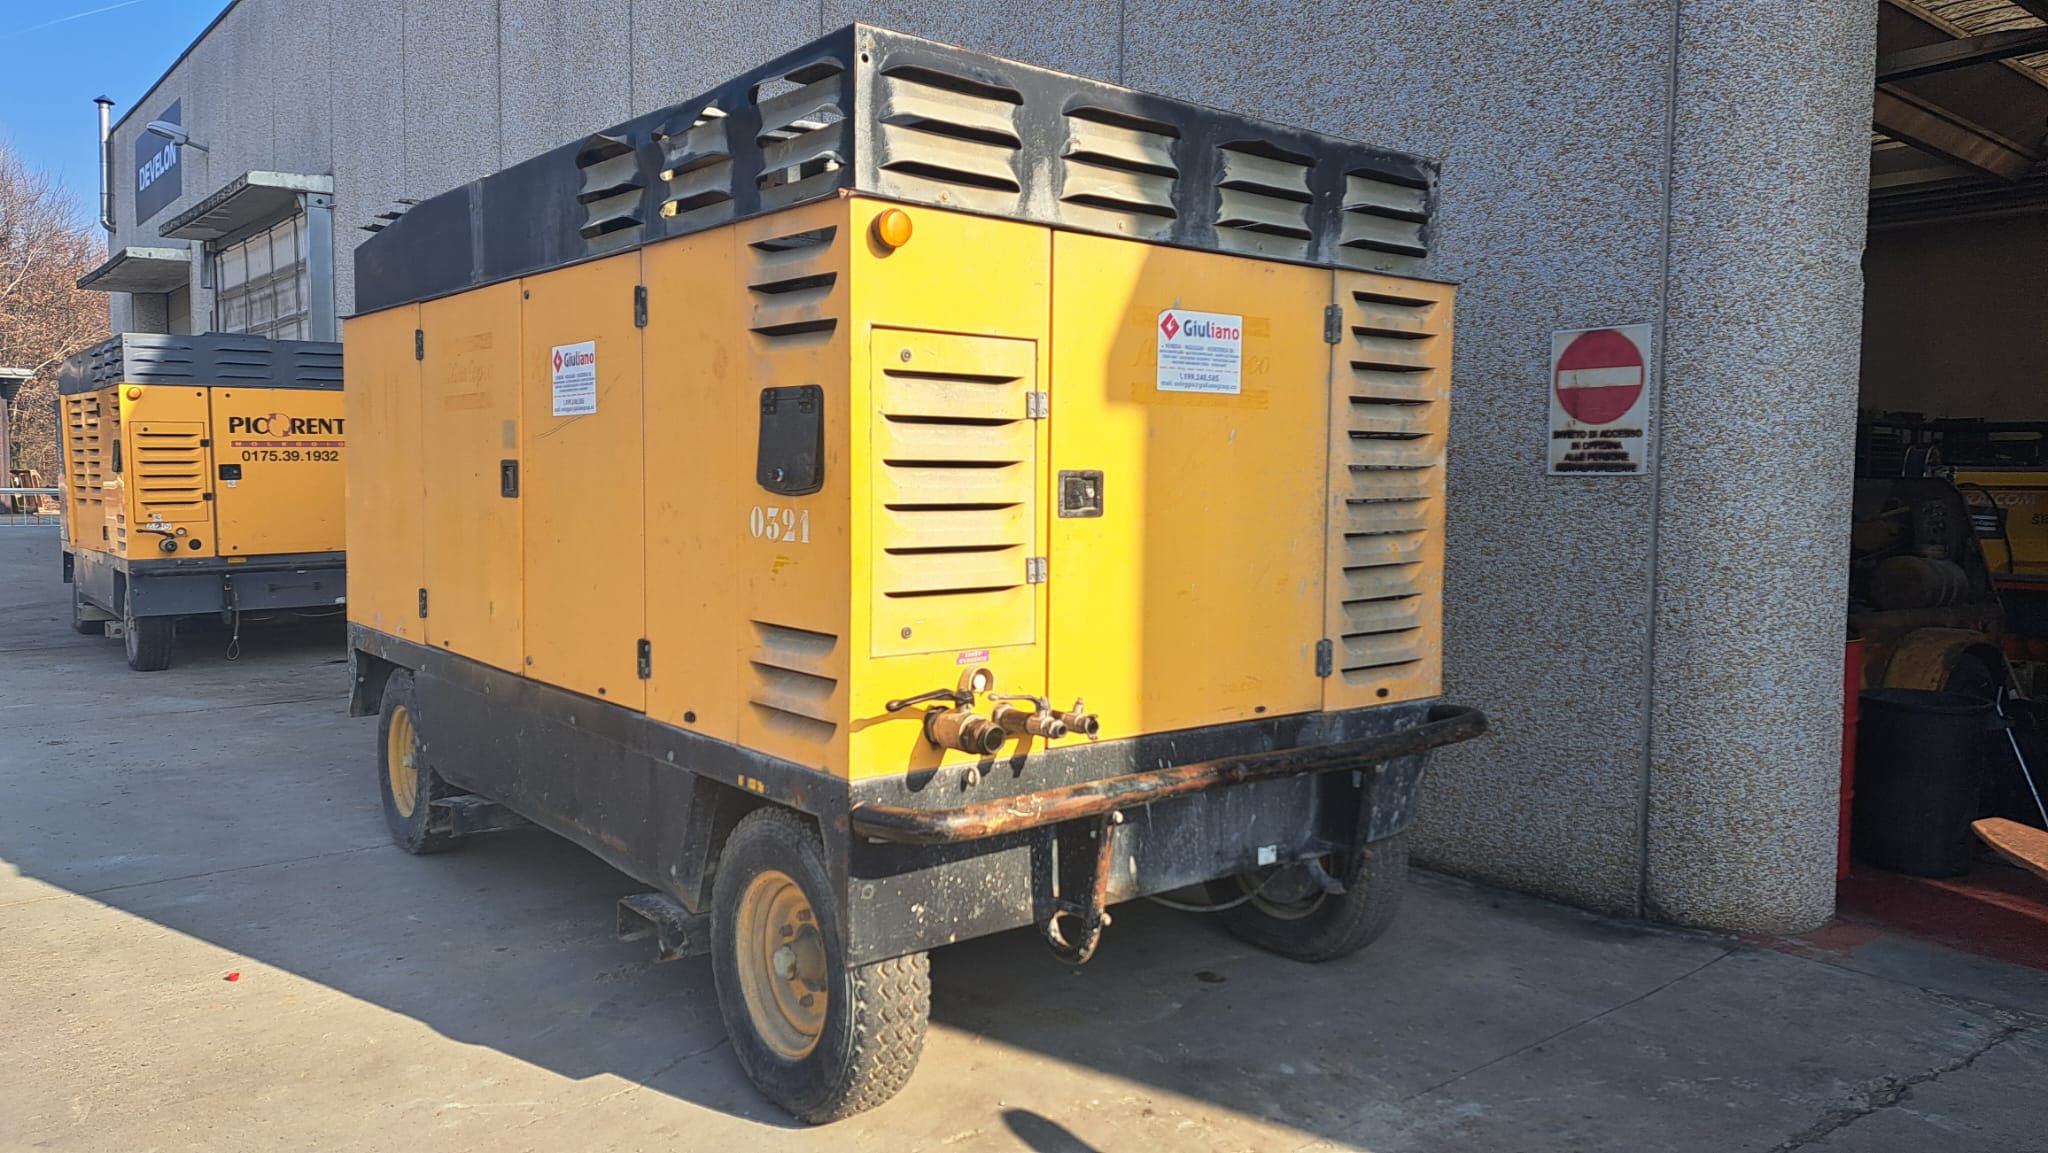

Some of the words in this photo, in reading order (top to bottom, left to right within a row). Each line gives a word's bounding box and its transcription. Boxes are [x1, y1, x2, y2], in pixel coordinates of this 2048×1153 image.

[139, 141, 177, 192] DEVELON
[1183, 319, 1240, 341] Giuliano
[564, 351, 594, 367] Giuliano
[242, 450, 339, 462] 0175.39.1932
